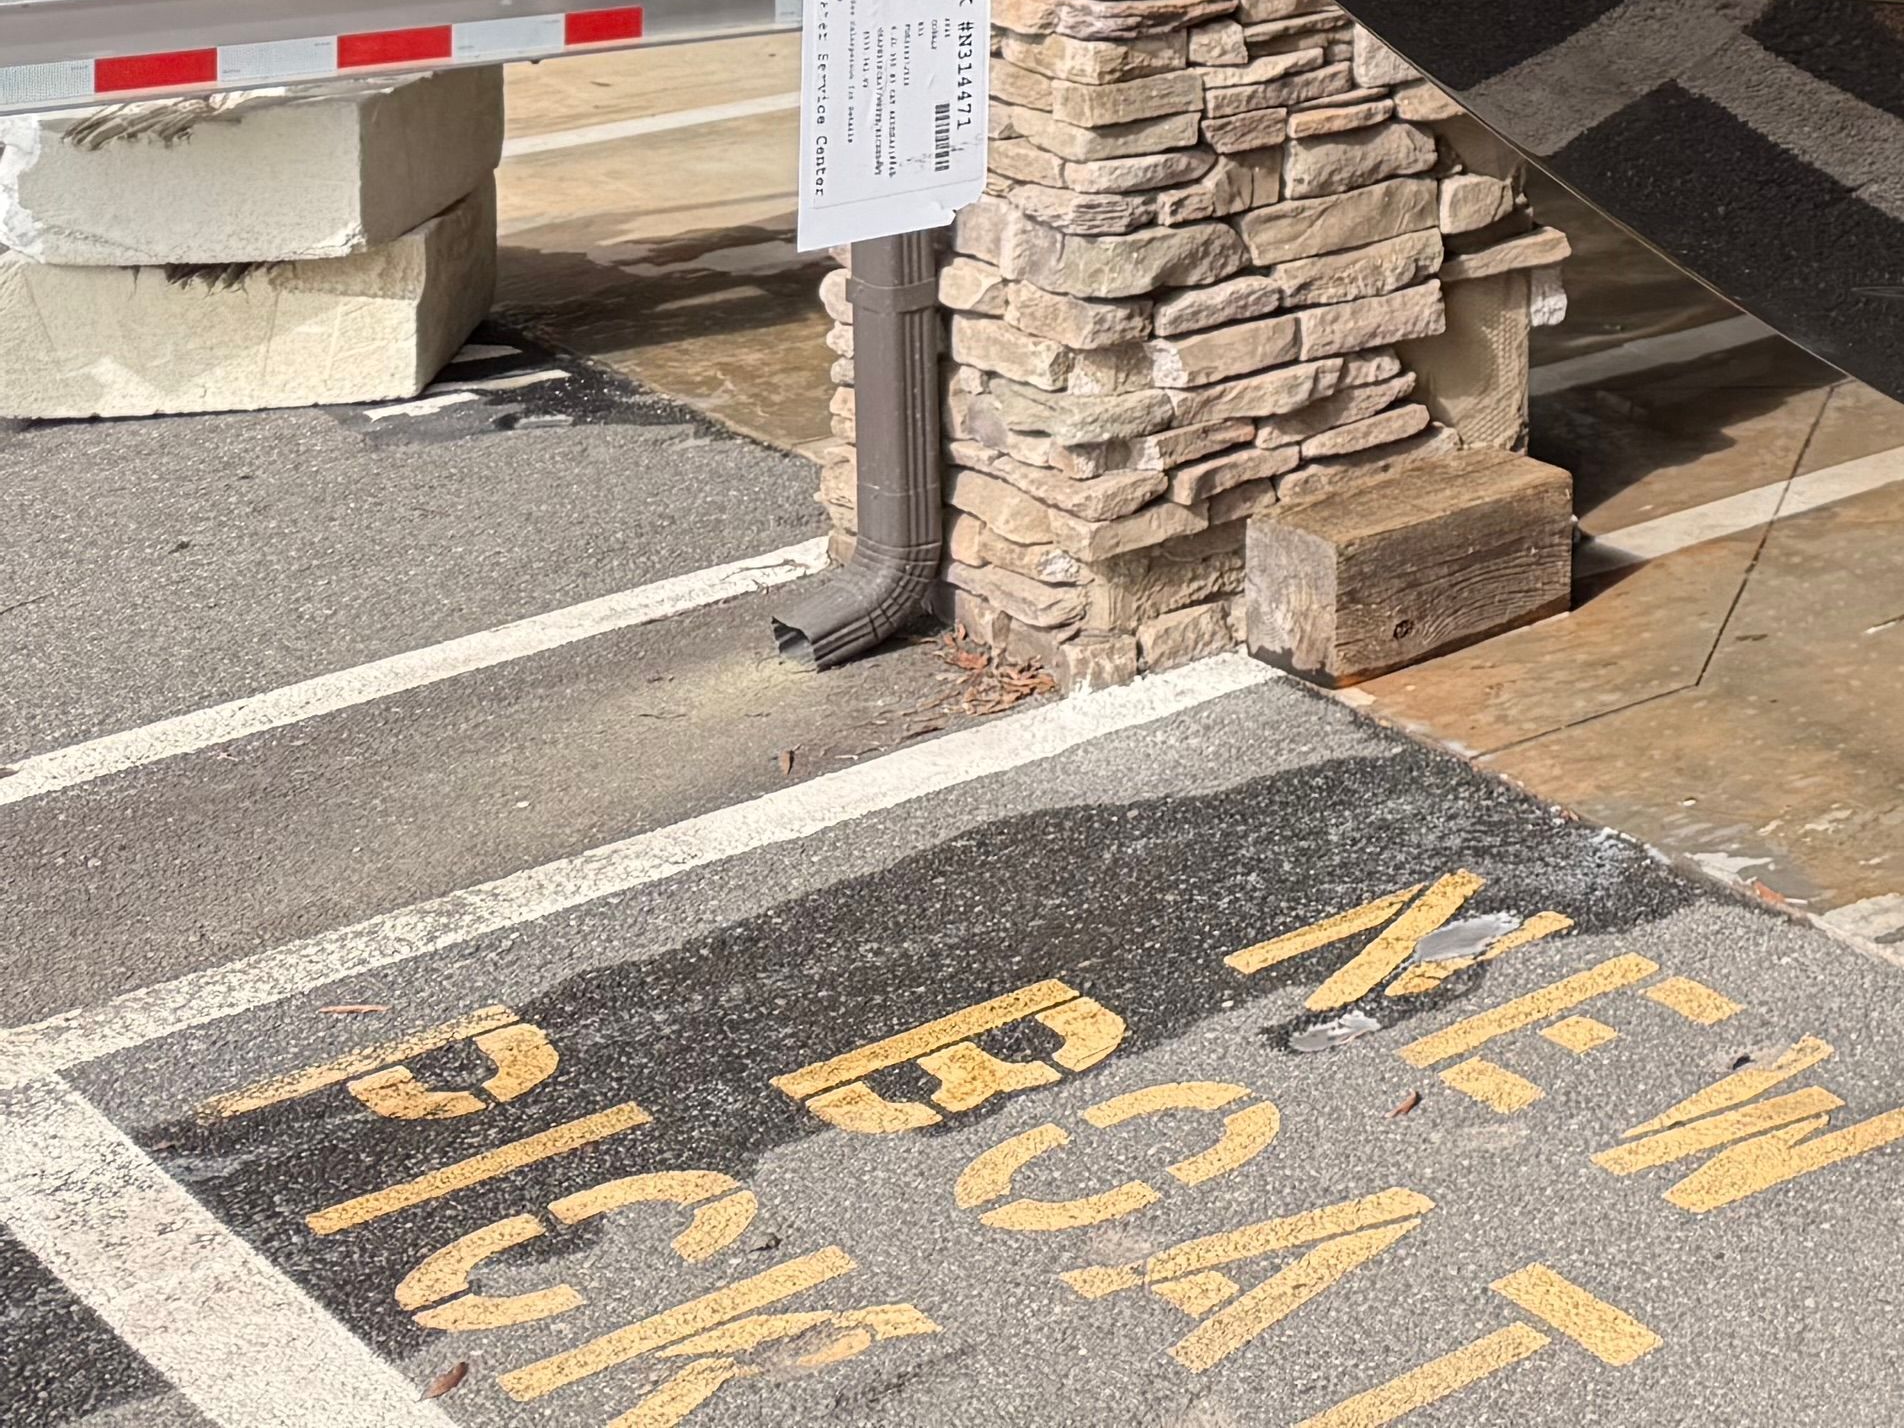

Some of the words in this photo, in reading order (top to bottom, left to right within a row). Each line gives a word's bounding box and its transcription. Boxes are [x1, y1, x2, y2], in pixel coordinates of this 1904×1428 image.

[814, 135, 827, 197] Center
[956, 21, 974, 131] #N314471
[198, 1004, 941, 1428] PICK
[769, 978, 1664, 1428] BOAT
